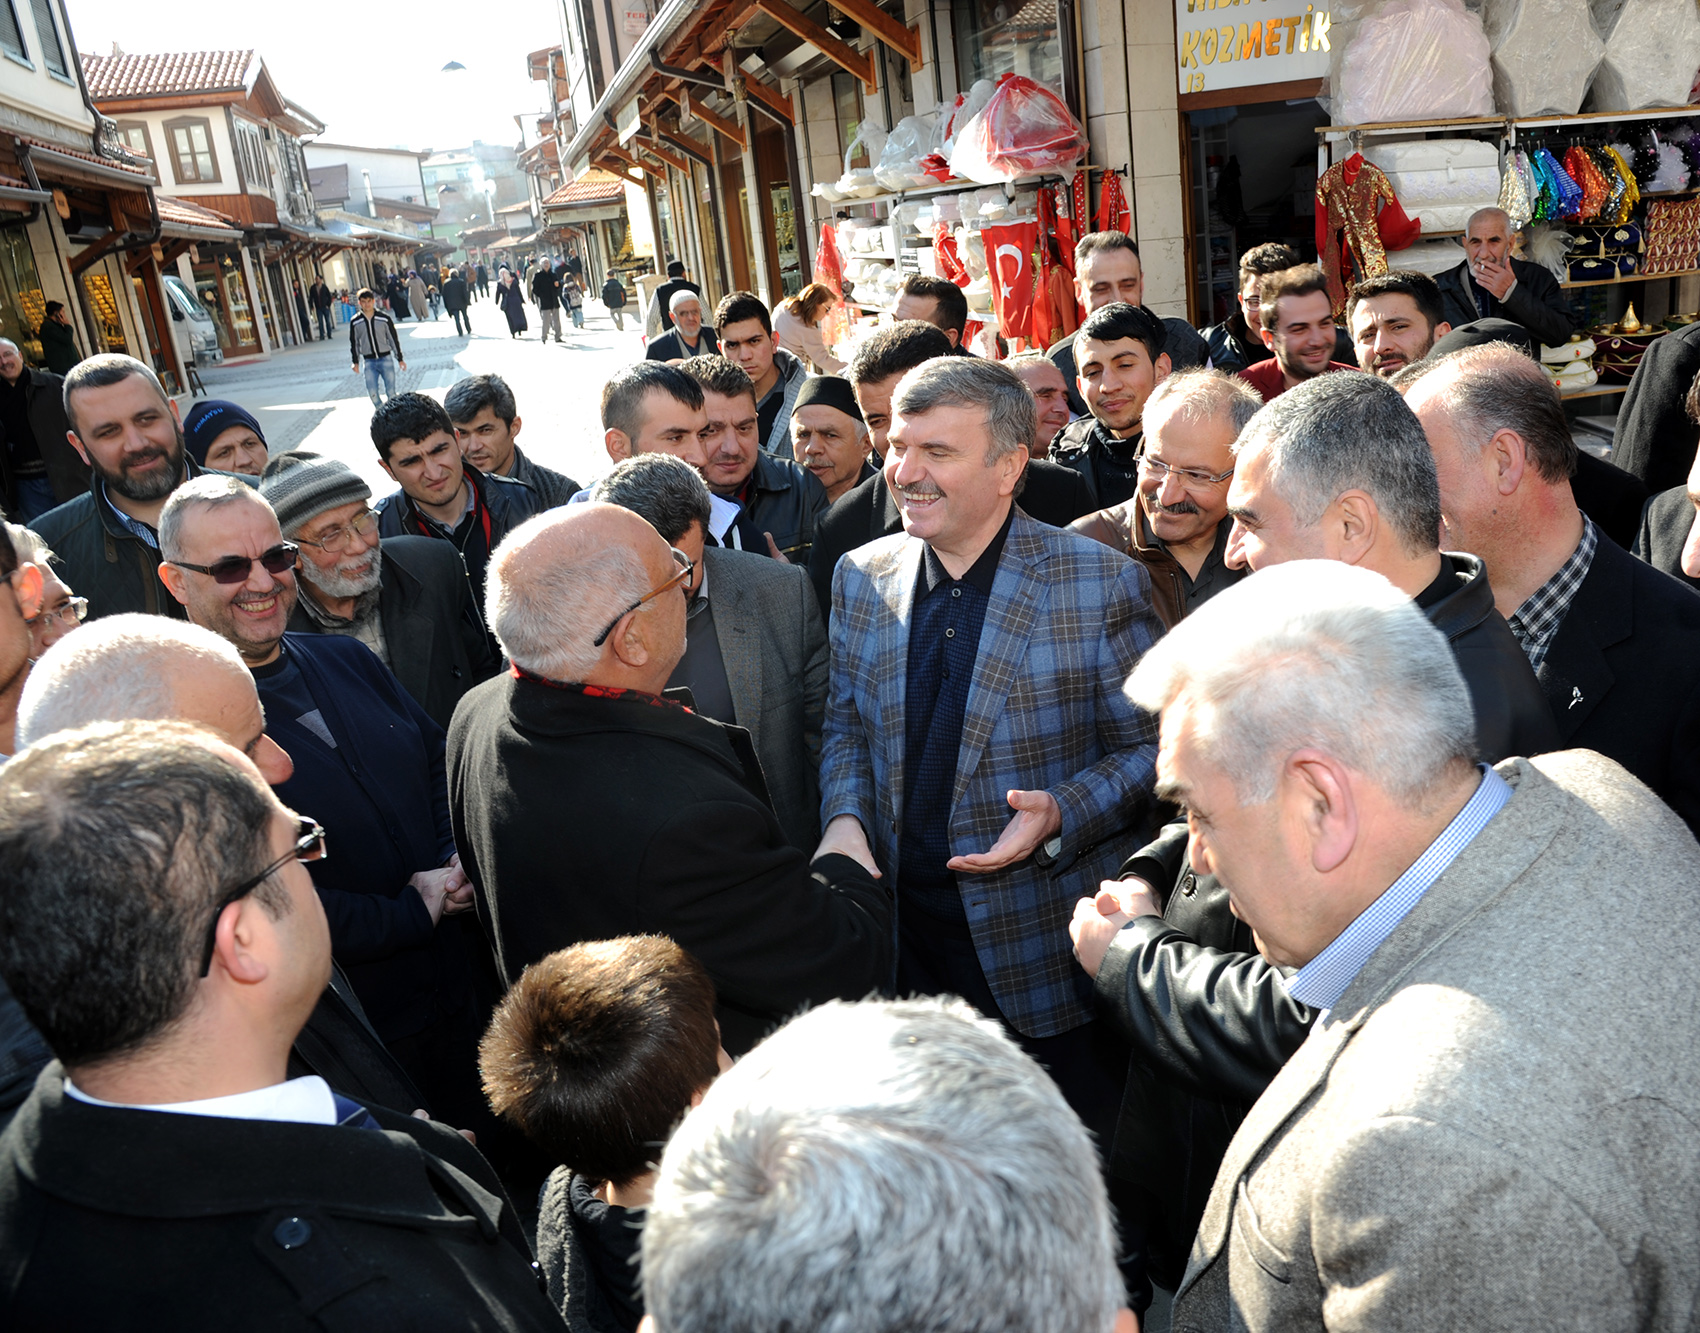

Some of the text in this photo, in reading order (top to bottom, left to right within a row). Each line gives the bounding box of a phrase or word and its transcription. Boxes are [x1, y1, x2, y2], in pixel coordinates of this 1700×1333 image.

[1181, 4, 1331, 69] KOZMETİK
[1186, 72, 1205, 93] 13
[193, 407, 224, 433] KOMATSU
